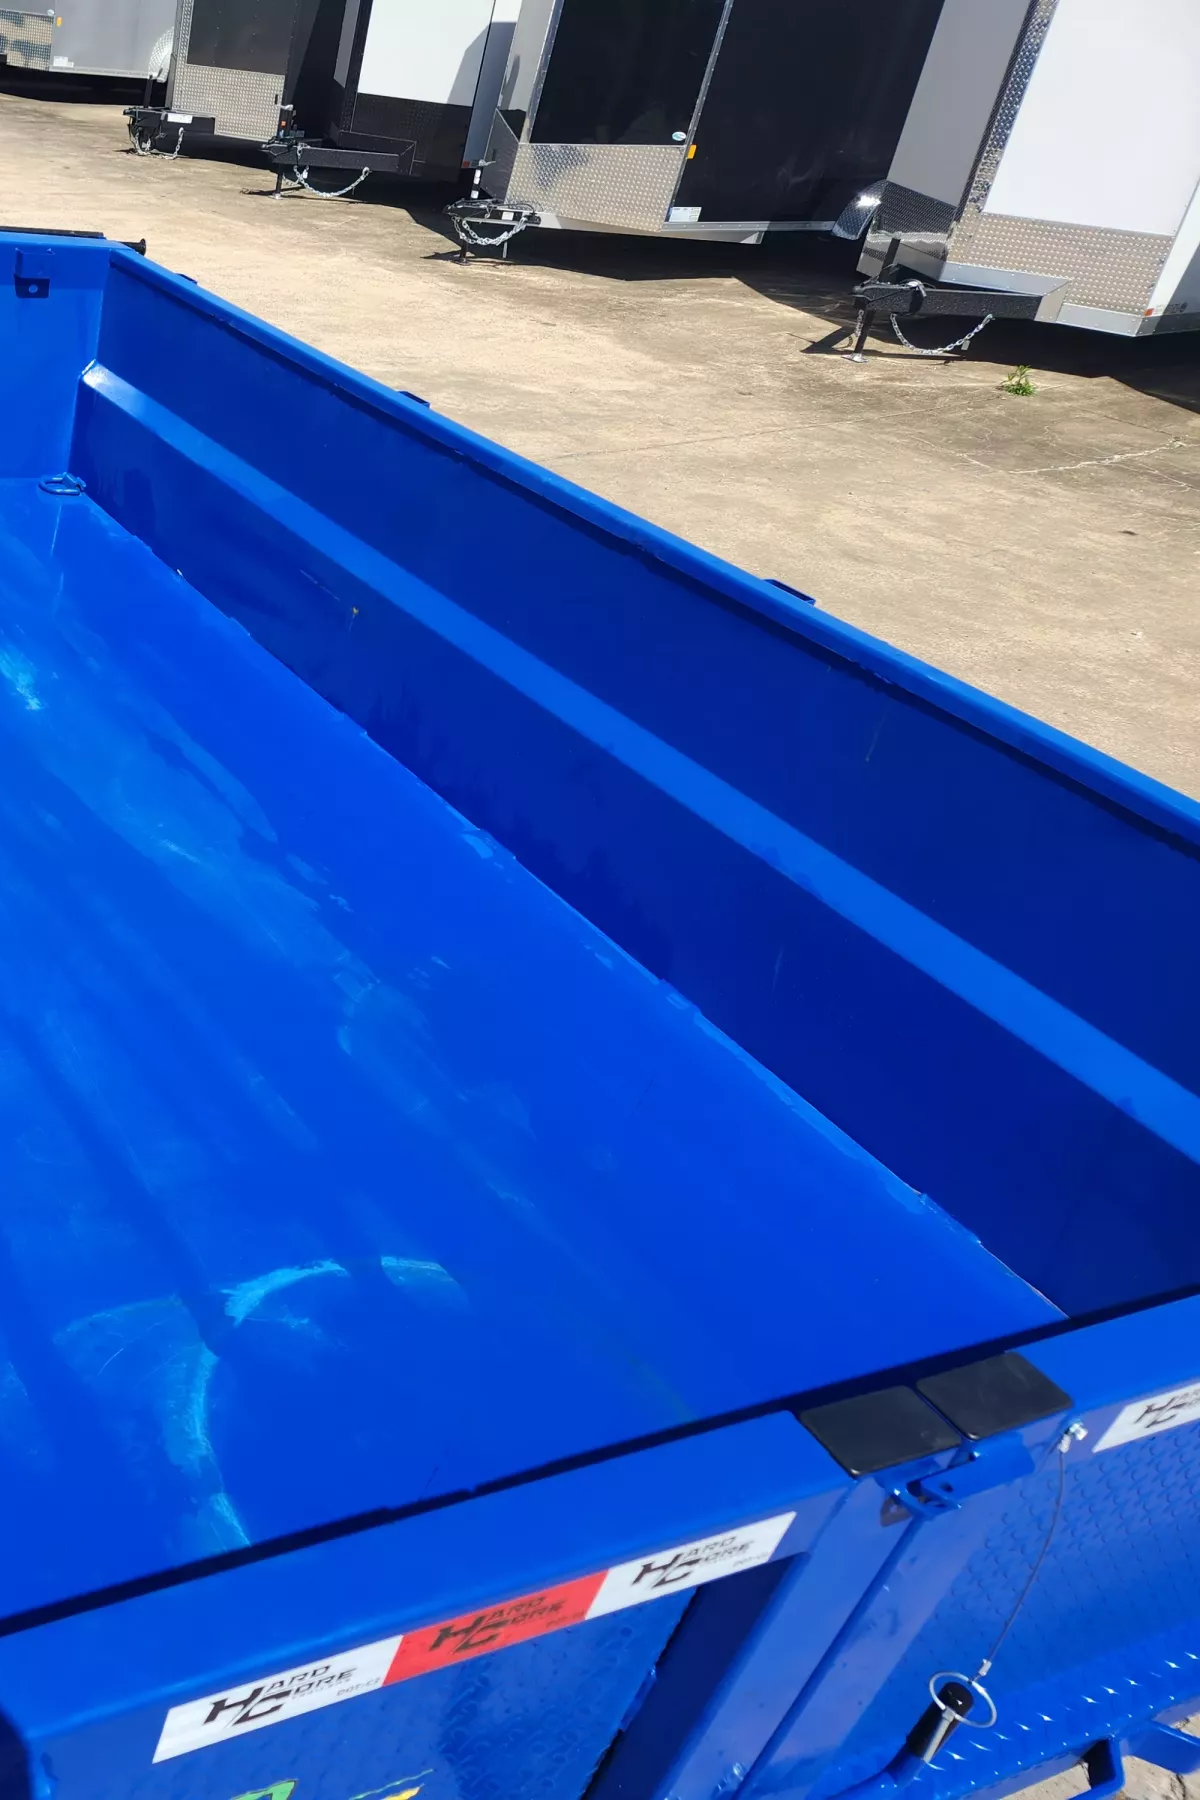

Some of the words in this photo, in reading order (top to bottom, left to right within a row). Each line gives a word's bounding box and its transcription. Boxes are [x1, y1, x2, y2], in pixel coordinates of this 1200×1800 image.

[632, 1535, 737, 1585] HARD
[428, 1596, 545, 1652] HARD
[202, 1664, 330, 1725] HARD
